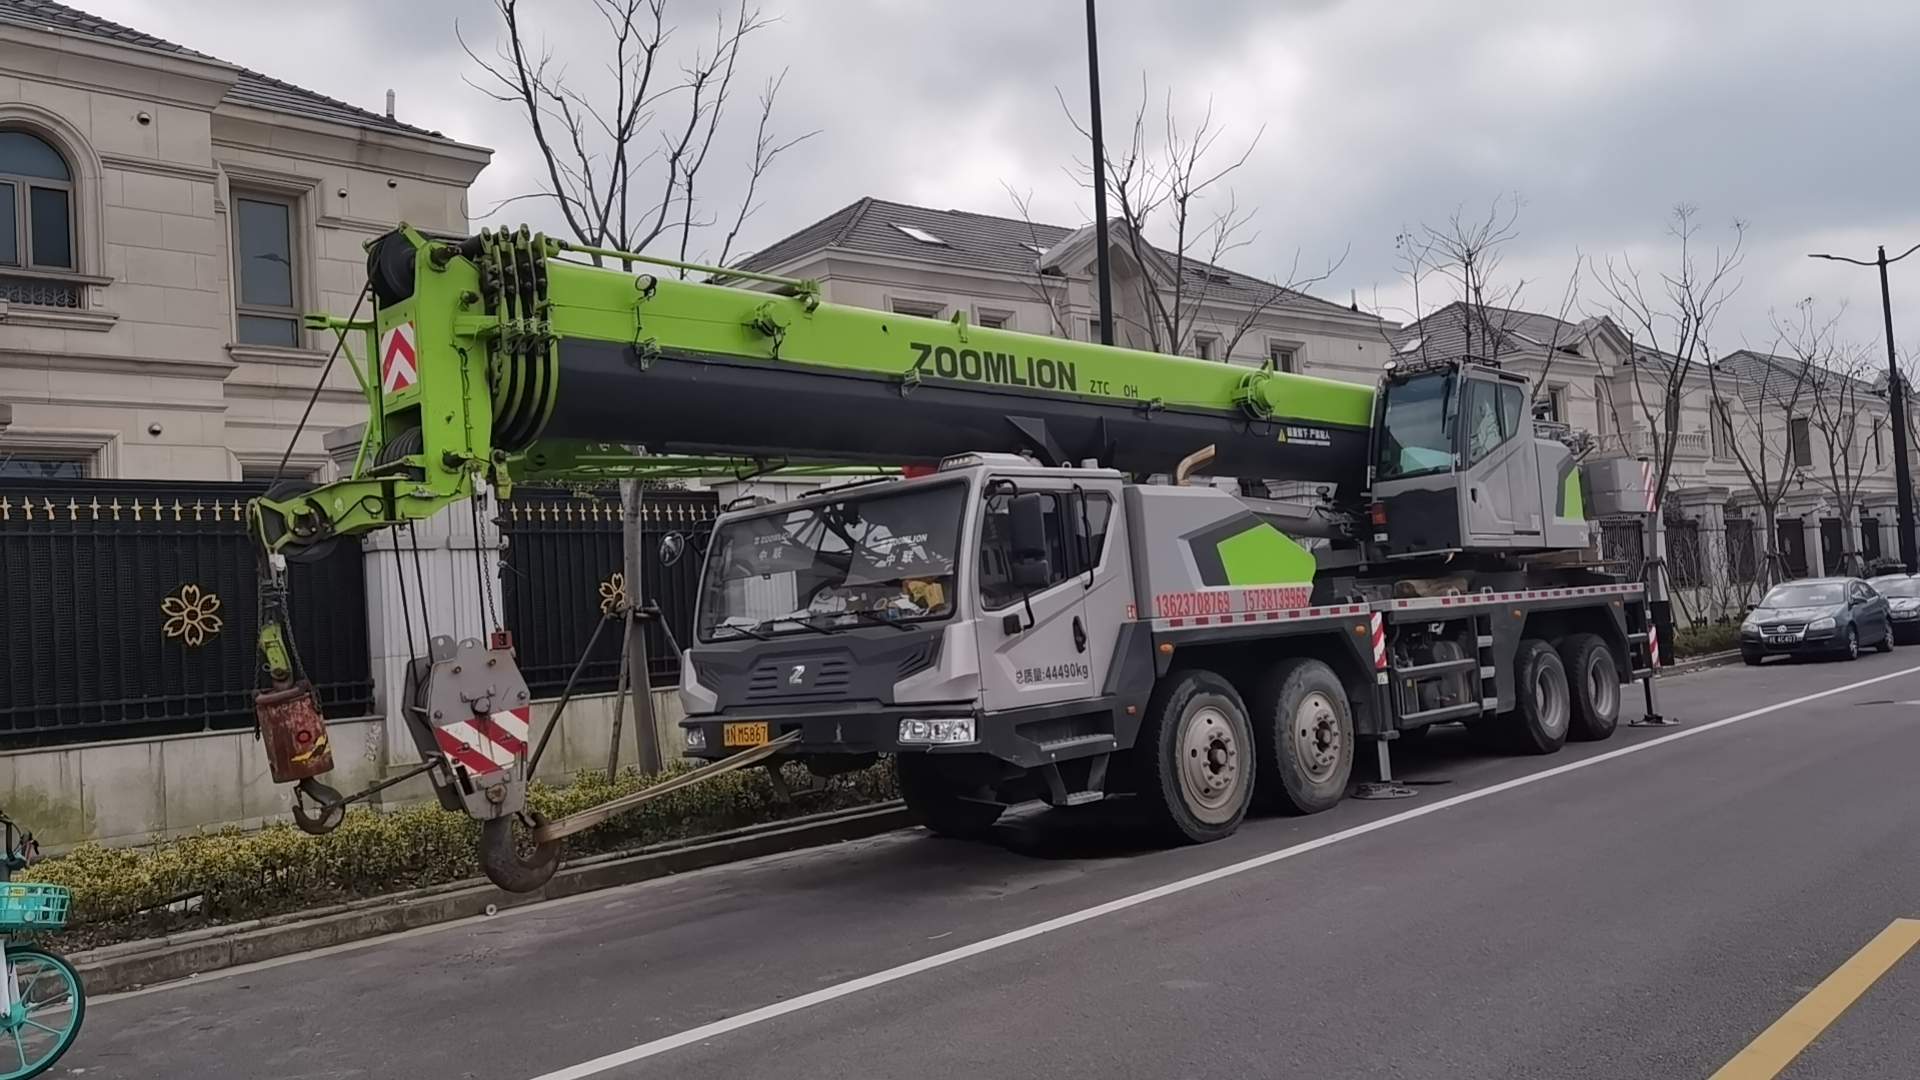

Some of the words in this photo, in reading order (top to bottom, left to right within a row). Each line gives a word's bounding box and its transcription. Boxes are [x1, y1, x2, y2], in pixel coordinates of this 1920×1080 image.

[910, 342, 1077, 391] ZOOMLION
[1090, 380, 1110, 395] ZTC
[1156, 591, 1230, 617] 13623708769
